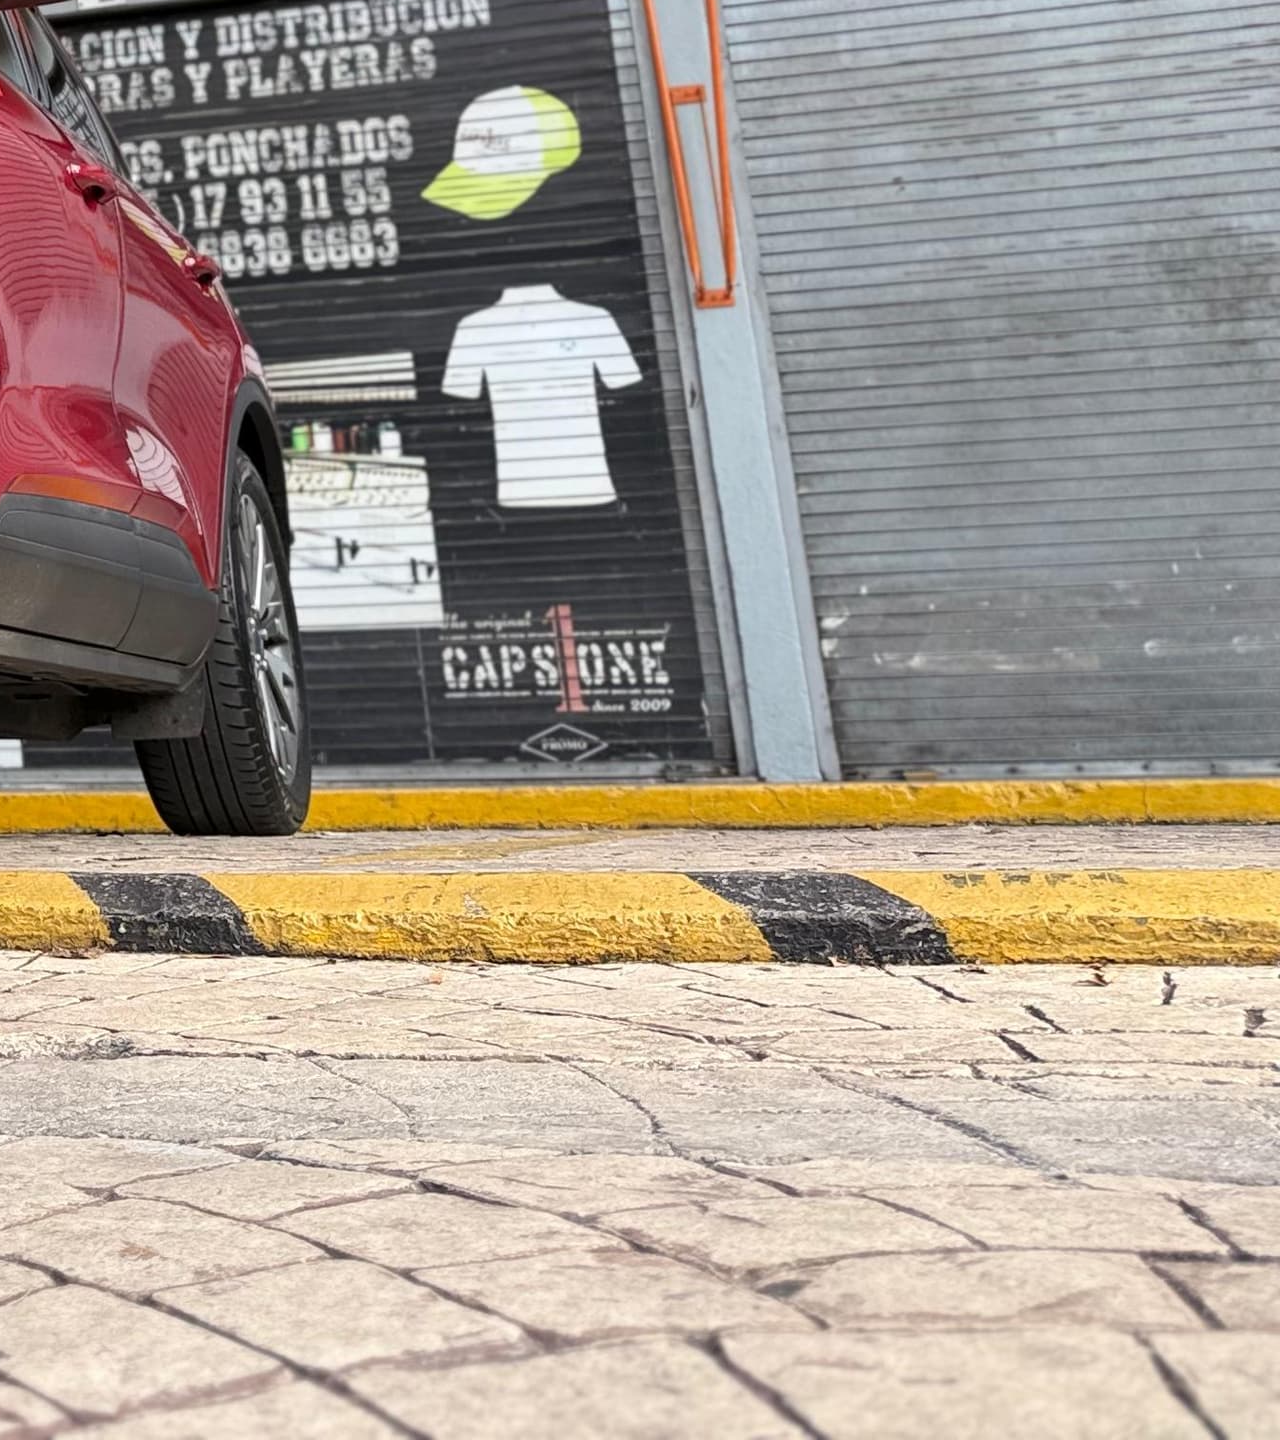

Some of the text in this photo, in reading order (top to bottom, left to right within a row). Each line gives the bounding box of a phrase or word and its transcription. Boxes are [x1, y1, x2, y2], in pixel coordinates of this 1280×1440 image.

[176, 21, 203, 59] Y
[185, 63, 211, 104] Y
[223, 37, 437, 100] PLAYERAS
[190, 182, 227, 229] 17
[239, 177, 288, 224] 93
[296, 173, 332, 220] 11
[341, 167, 392, 215] 55
[630, 698, 671, 711] 2009
